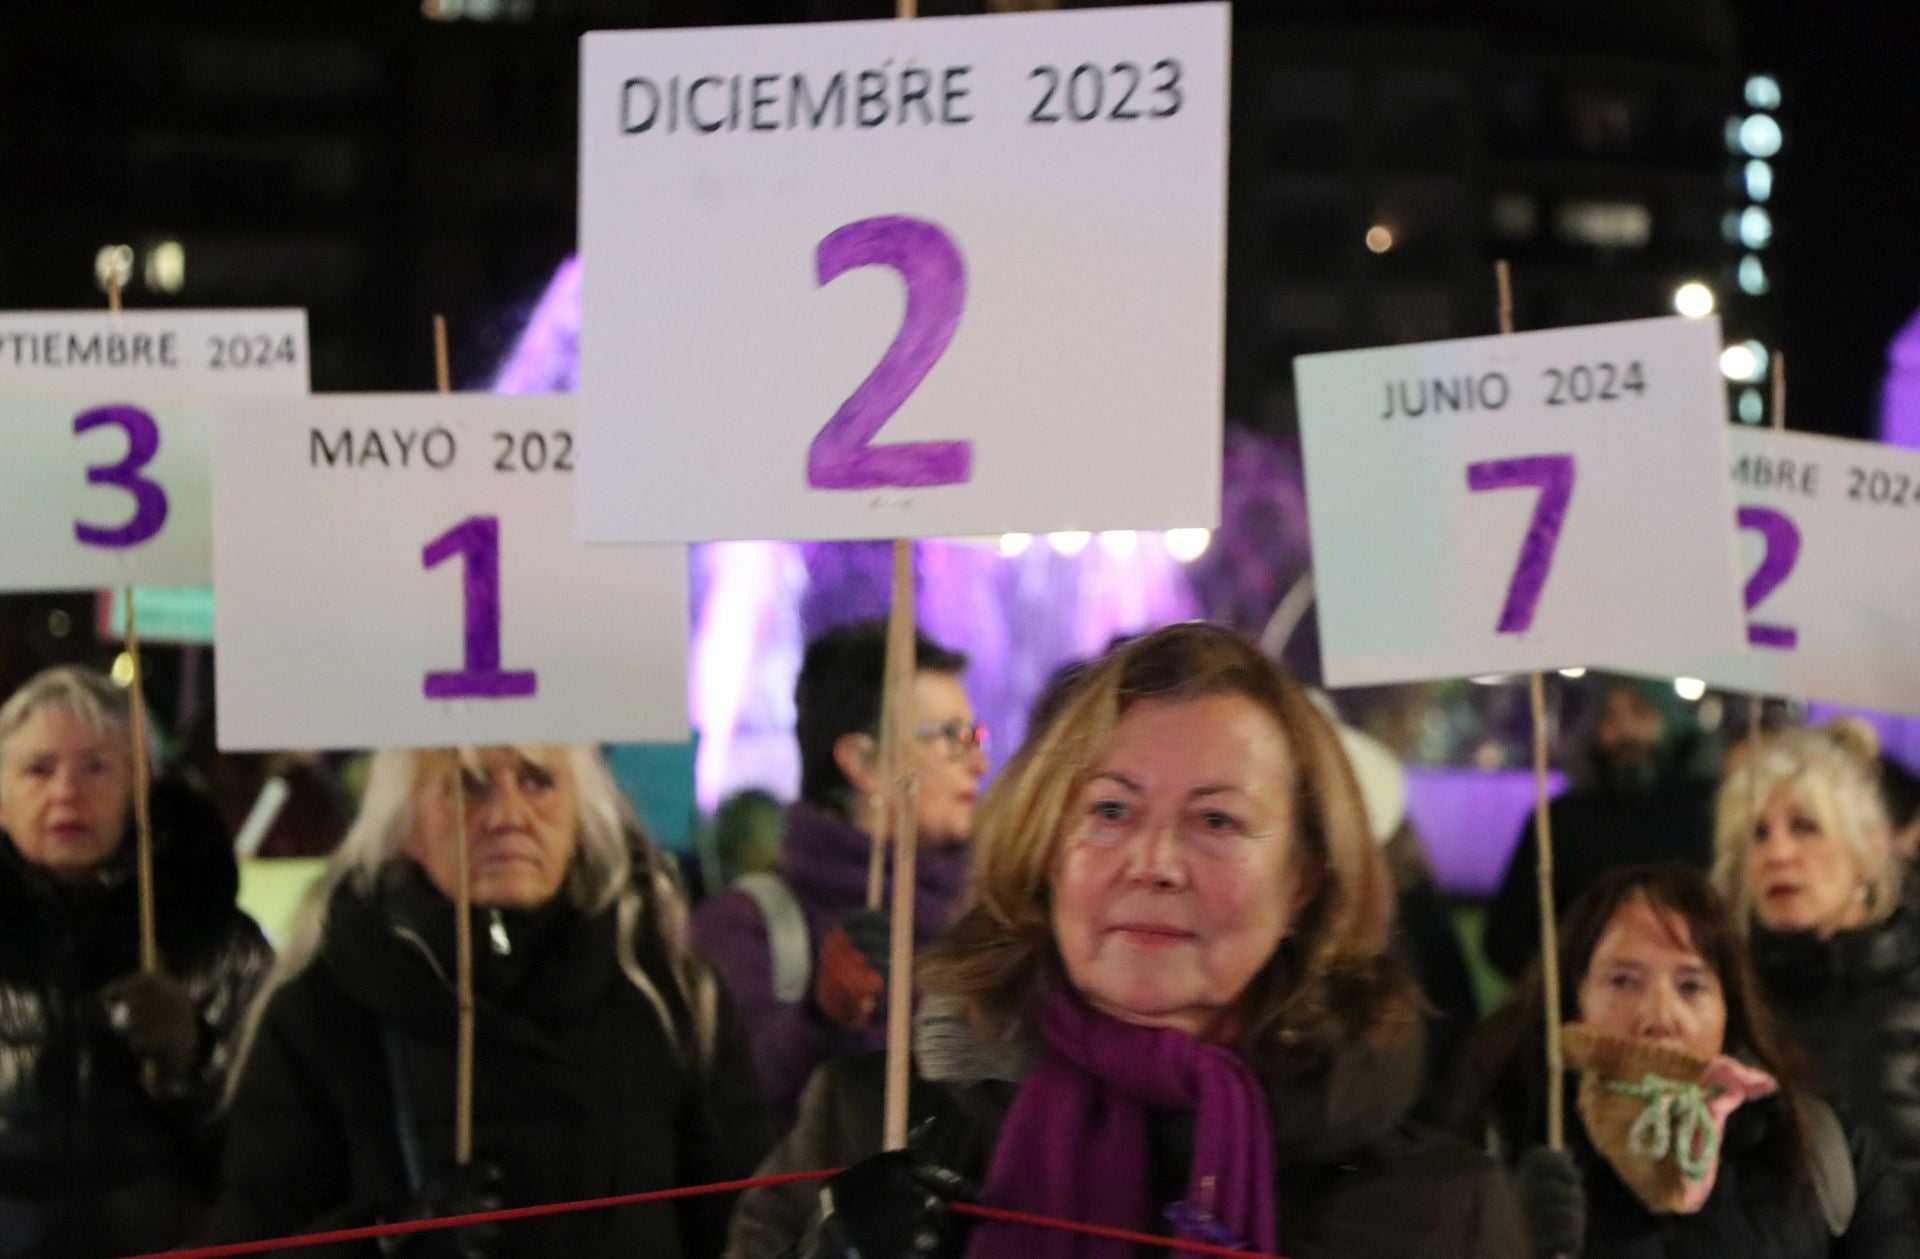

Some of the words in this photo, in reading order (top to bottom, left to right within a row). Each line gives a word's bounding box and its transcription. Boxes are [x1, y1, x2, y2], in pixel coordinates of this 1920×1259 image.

[619, 65, 974, 135] DICIEMBRE
[1027, 58, 1184, 125] 2023
[0, 331, 179, 368] TIEMBRE
[207, 334, 298, 369] 2024
[807, 214, 973, 491] 2
[1382, 371, 1509, 420] JUNIO
[1545, 361, 1648, 406] 2024
[72, 404, 168, 549] 3
[309, 427, 456, 470] MAYO
[493, 430, 574, 472] 202
[421, 514, 537, 699] 1
[1466, 454, 1575, 634] 7
[1735, 504, 1802, 650] 2
